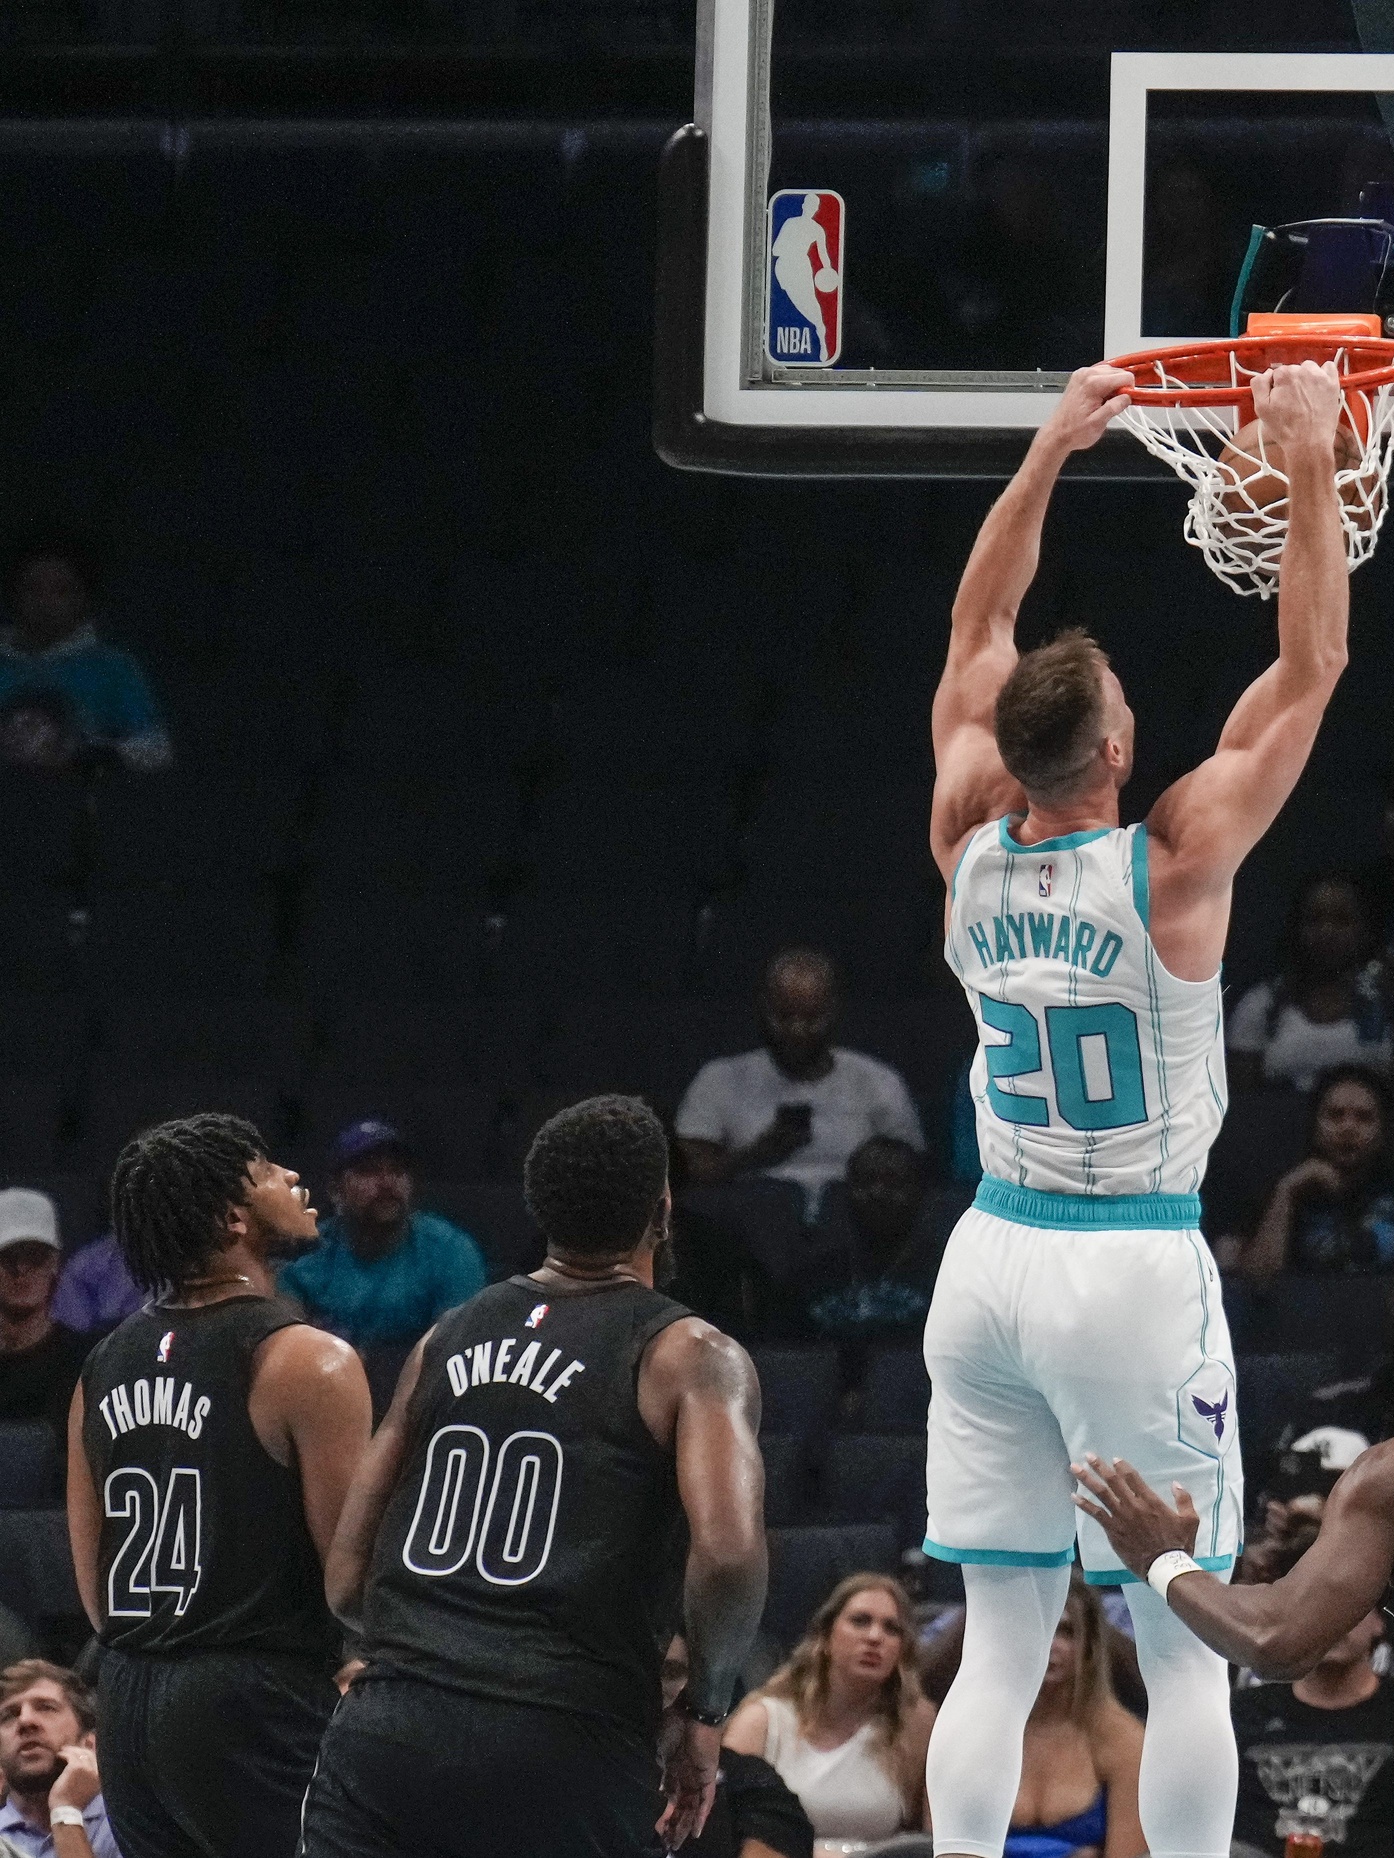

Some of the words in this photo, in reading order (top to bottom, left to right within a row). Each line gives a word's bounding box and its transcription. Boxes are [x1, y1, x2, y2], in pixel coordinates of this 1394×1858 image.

[776, 326, 812, 354] NBA
[968, 911, 1124, 979] HAYWARD
[979, 991, 1149, 1132] 20
[446, 1337, 586, 1404] O'NEALE
[98, 1376, 212, 1441] THOMAS
[402, 1424, 564, 1586] 00
[103, 1466, 202, 1617] 24
